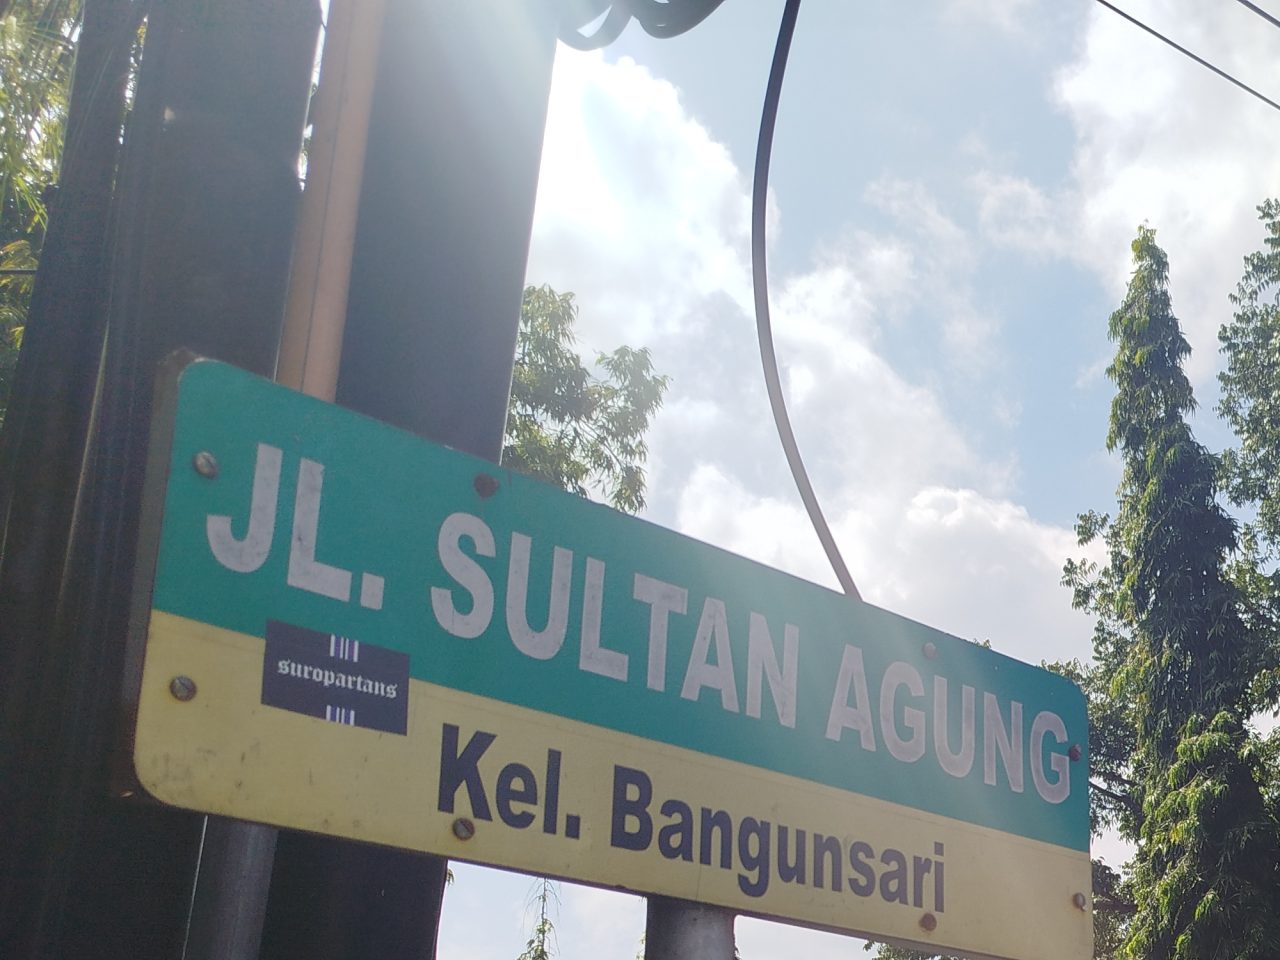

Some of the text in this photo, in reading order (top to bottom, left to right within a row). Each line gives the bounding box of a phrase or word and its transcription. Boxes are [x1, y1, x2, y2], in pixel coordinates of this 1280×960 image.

[205, 443, 1071, 805] JL. SULTAN AGUNG
[277, 658, 398, 699] suropartans
[437, 721, 947, 914] Kel. Bangunsari
